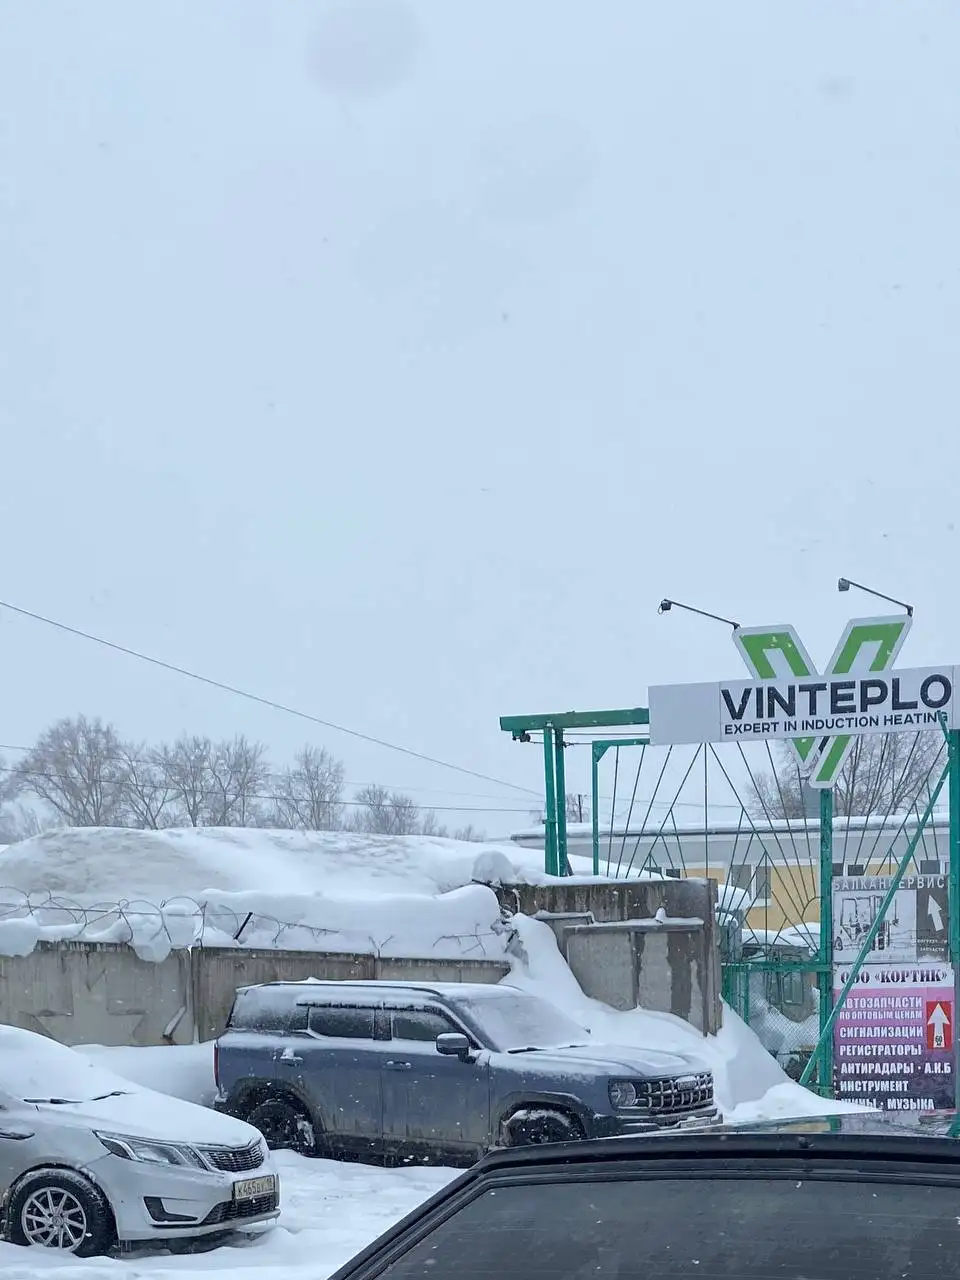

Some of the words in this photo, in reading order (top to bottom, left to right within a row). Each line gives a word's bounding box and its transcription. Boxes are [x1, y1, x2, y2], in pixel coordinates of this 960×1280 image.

[721, 674, 952, 720] VINTEPLO
[724, 721, 779, 735] EXPERT
[784, 721, 797, 731] IN
[801, 715, 879, 730] INDUCTION
[884, 711, 948, 727] HEATING
[833, 876, 945, 890] БАЛКАНЕРВИС
[840, 1012, 850, 1020] ПО
[852, 1011, 893, 1020] ОПТОВЫМ
[895, 1010, 923, 1020] ЦЕНАМ
[840, 1026, 924, 1038] СИГНАЛИЗАЦИИ
[840, 1045, 922, 1056] РЕГИСТРАТОРЫ
[841, 1062, 914, 1075] АНТИРАДАРЫ
[840, 1080, 909, 1092] ИНСТРУМЕНТ
[887, 1098, 935, 1110] МУЗЫКА
